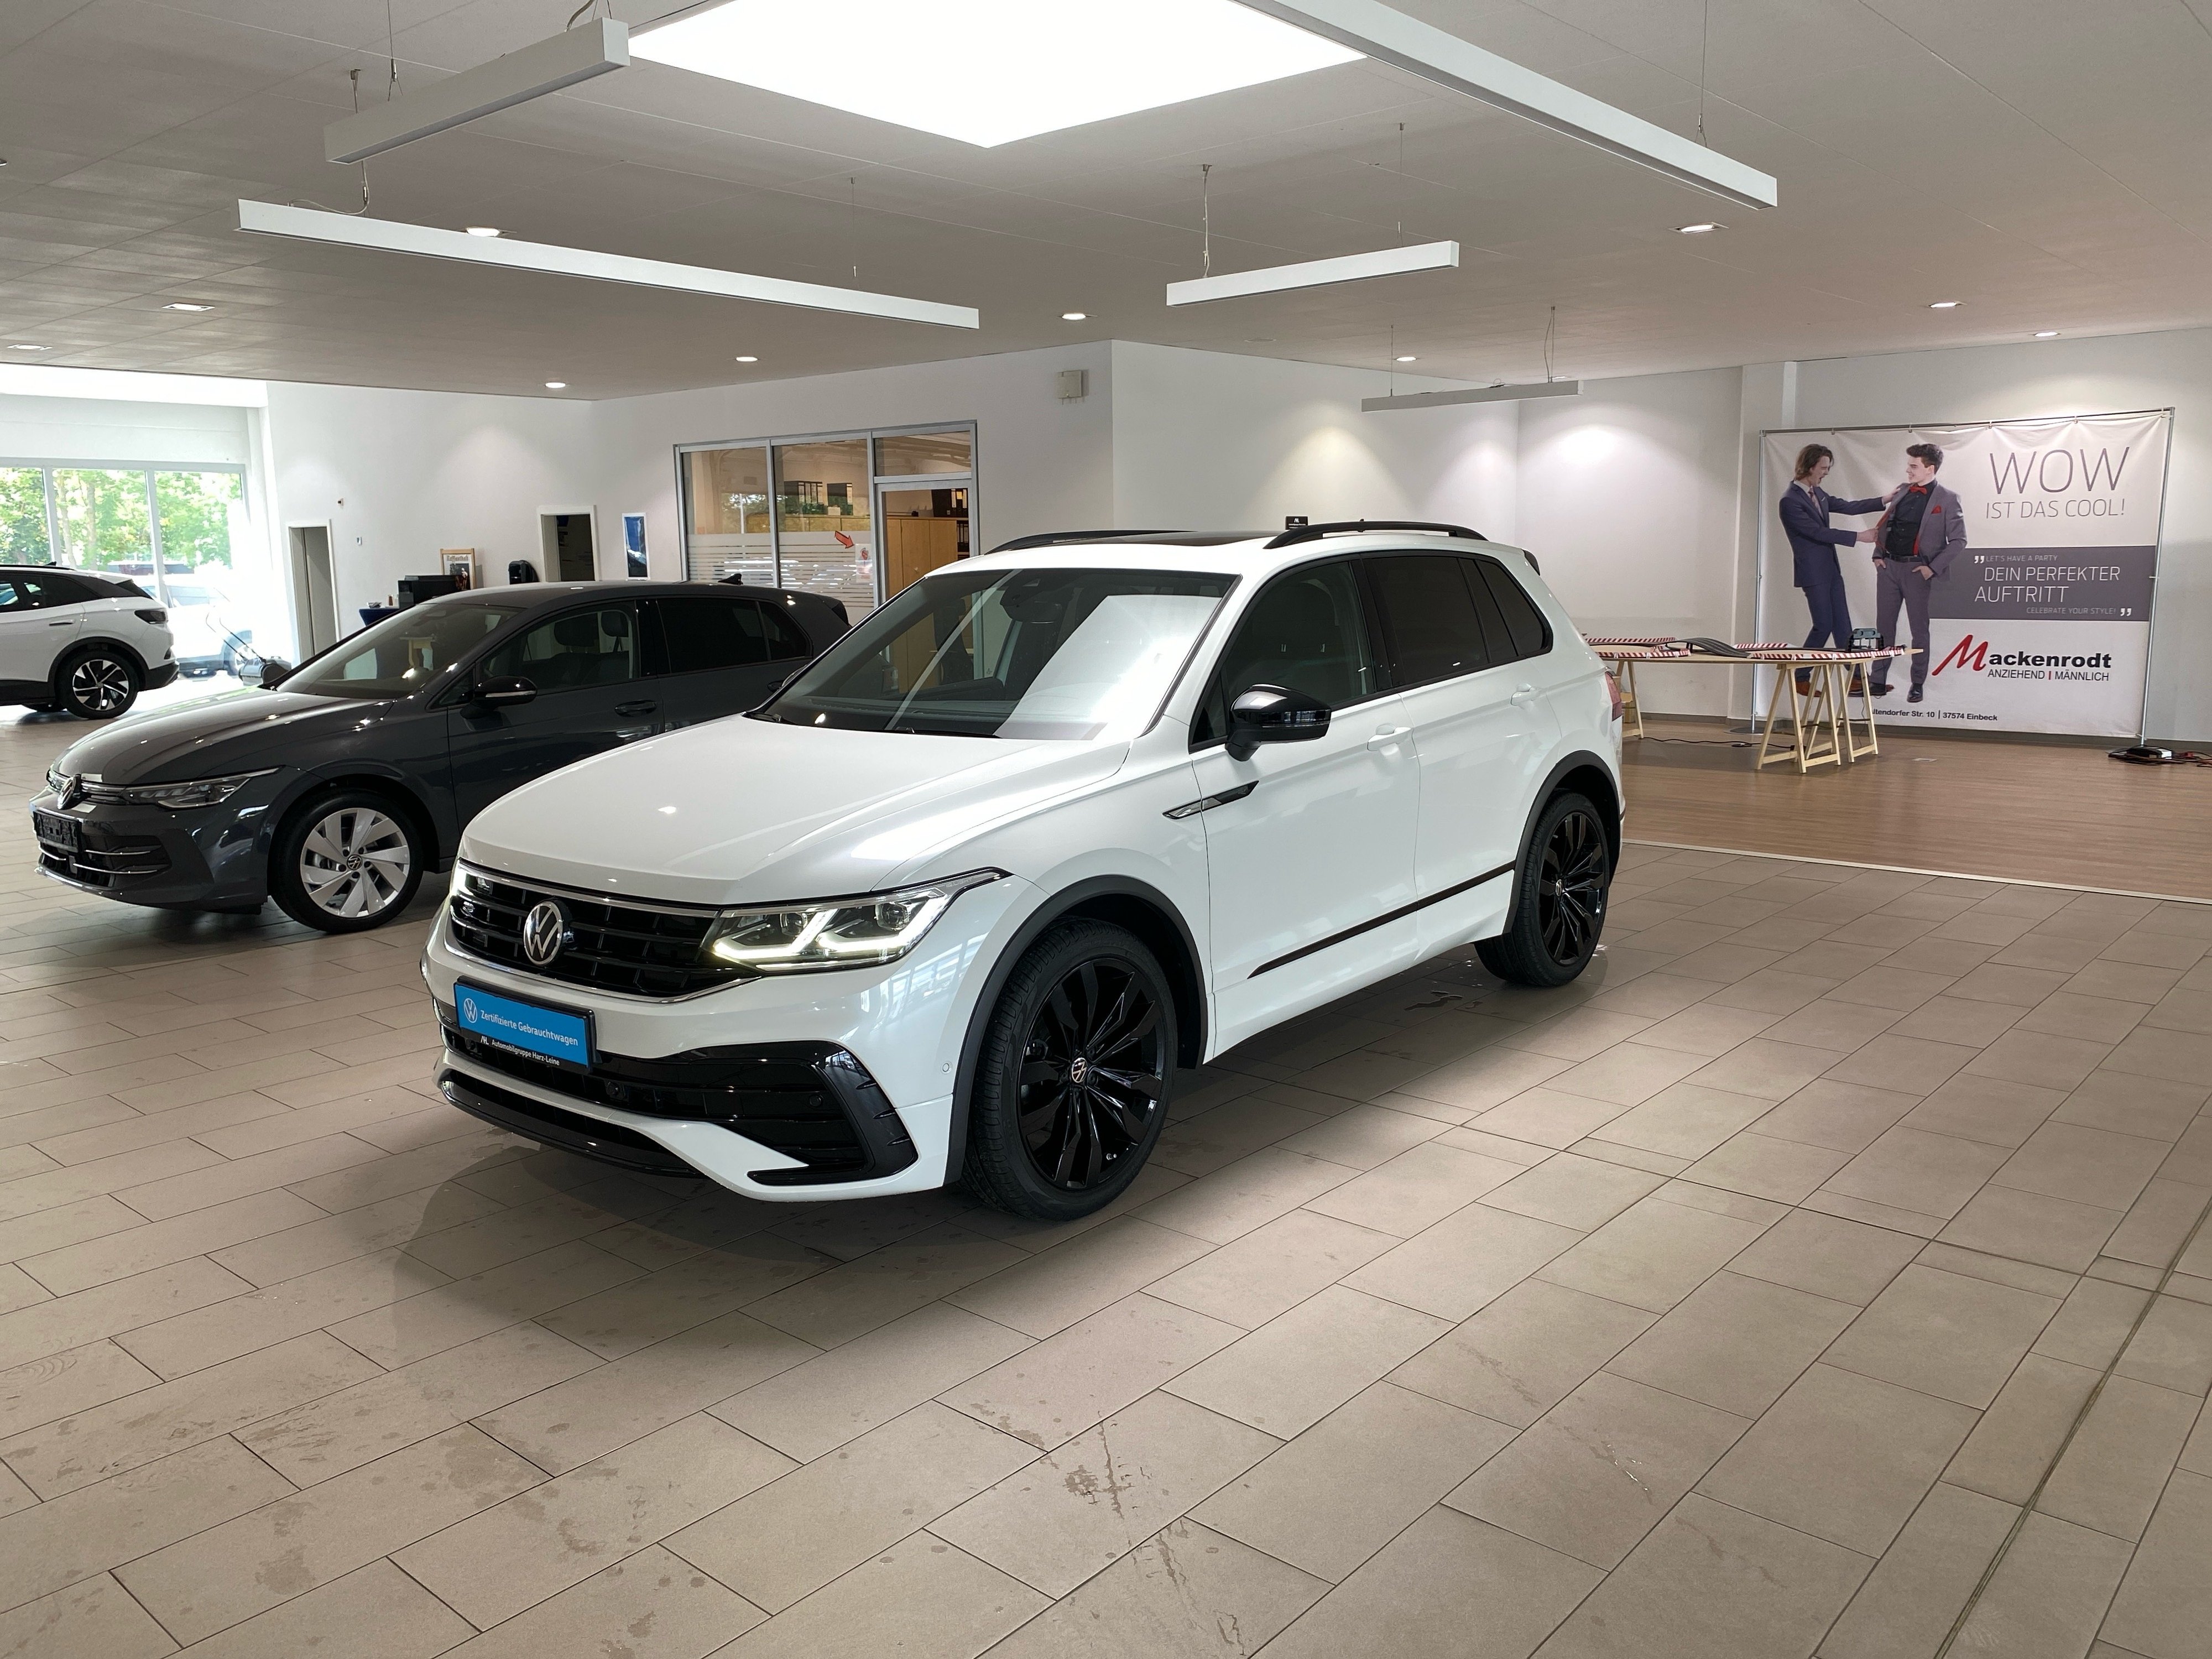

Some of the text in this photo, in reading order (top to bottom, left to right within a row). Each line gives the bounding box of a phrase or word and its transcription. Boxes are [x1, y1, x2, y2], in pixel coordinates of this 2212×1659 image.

[1989, 447, 2130, 494] WOW
[1986, 498, 2125, 519] IST DAS COOL!
[1984, 566, 2121, 581] DEIN PERFEKTER
[1974, 586, 2069, 603] AUFTRITT
[1932, 634, 2111, 676] Mackenrodt
[1987, 669, 2109, 681] ANZIEHEND MÄNNLICH
[1872, 708, 1910, 717] ltendorfer
[1966, 713, 1998, 721] Einbeck
[480, 1010, 578, 1046] Zertifizierte Gebrauchtwagen
[491, 1039, 532, 1057] Automobilgruppe
[532, 1051, 560, 1066] Harz-Leine
